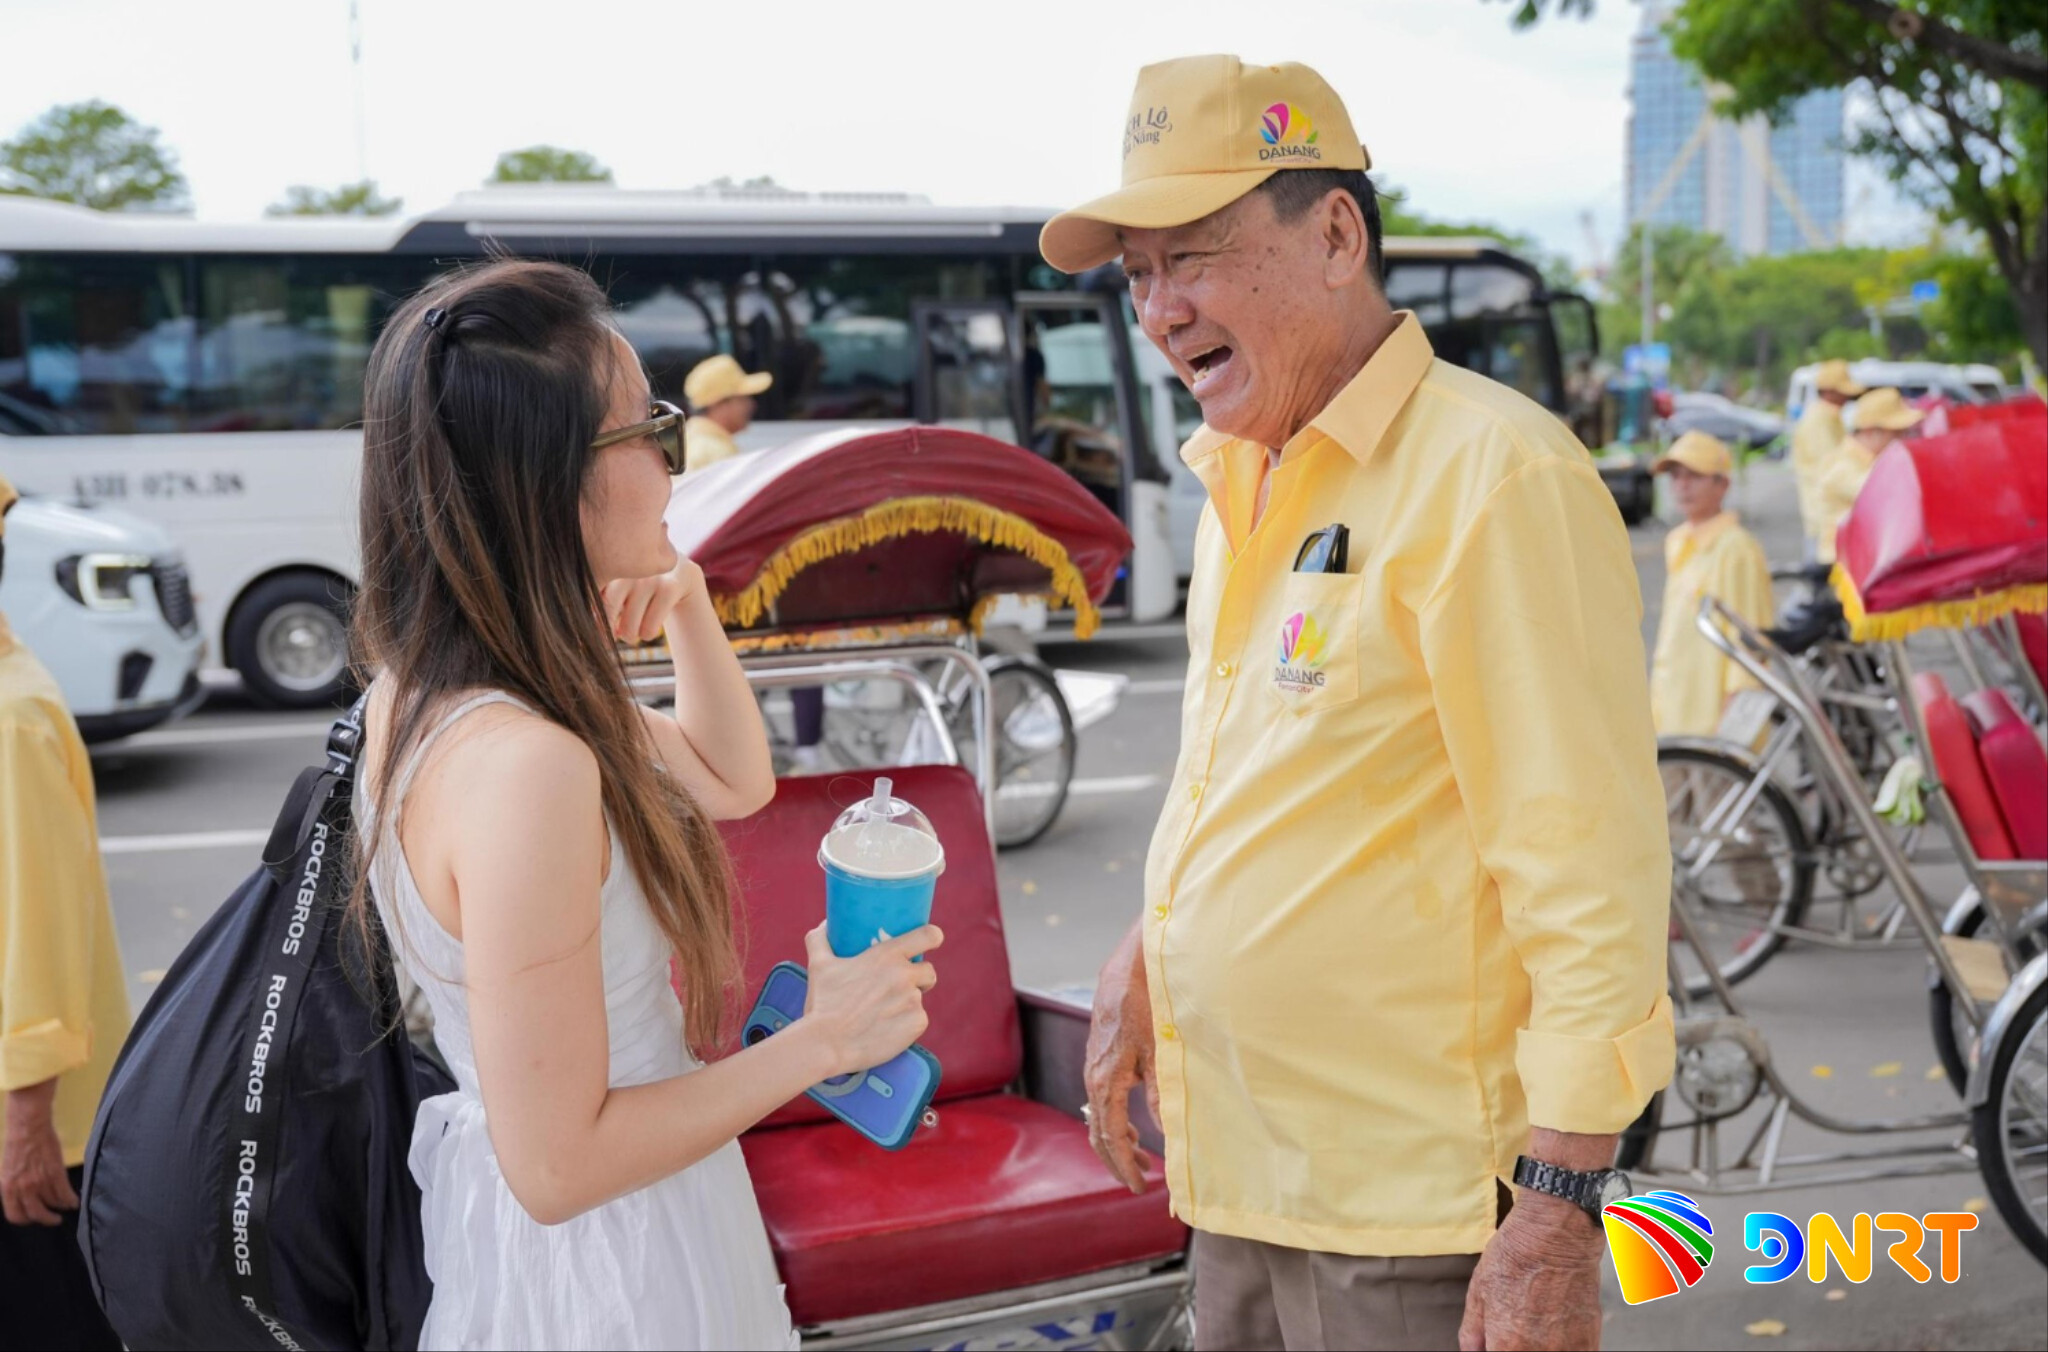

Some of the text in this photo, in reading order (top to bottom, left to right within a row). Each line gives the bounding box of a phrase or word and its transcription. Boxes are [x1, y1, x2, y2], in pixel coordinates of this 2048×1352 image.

[1259, 144, 1321, 161] DANANG
[1275, 667, 1326, 686] DANANG
[281, 822, 329, 956] ROCKBROS
[244, 975, 287, 1114] ROCKBROS
[232, 1139, 258, 1276] ROCKBROS
